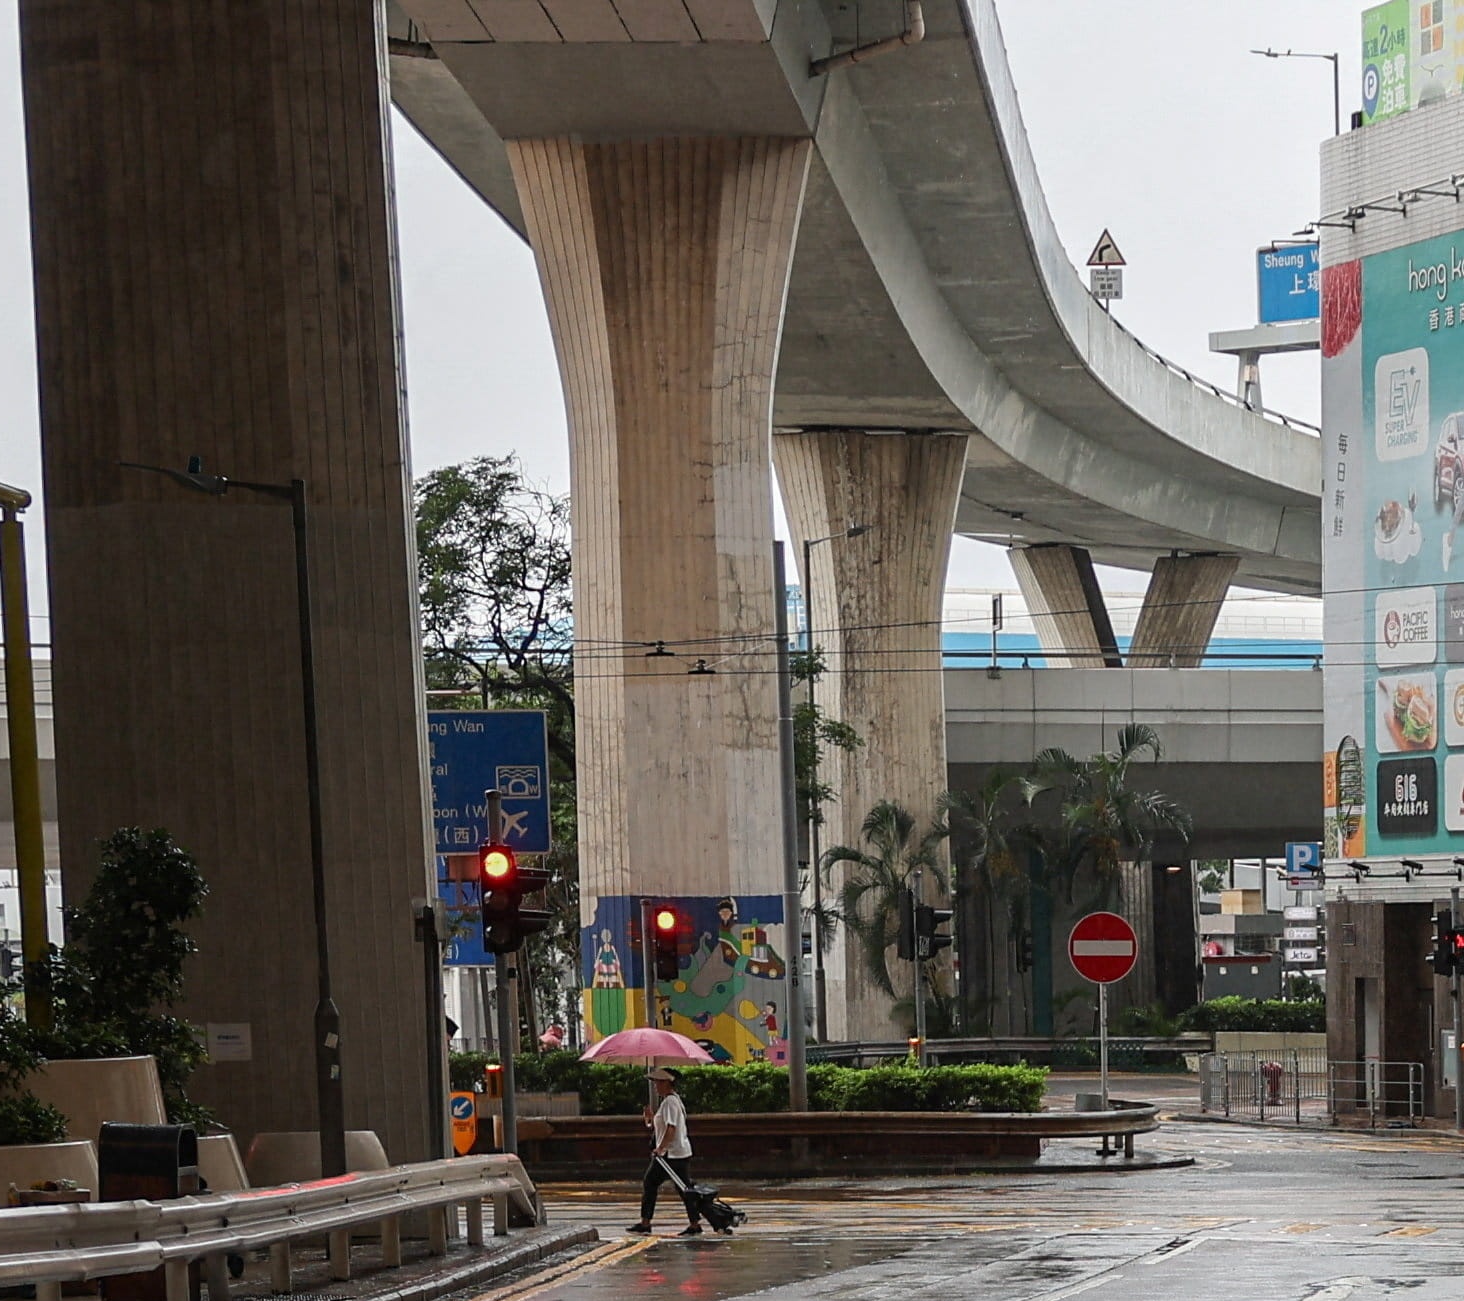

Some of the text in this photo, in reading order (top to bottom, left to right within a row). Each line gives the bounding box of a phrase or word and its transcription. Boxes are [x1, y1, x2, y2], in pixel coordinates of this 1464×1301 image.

[1264, 252, 1304, 269] Sheung
[1408, 259, 1447, 300] hong
[1385, 421, 1405, 434] SUPER
[1386, 431, 1418, 448] CHARGING
[1402, 611, 1429, 626] PACIFIC
[1403, 625, 1429, 641] COFFEE
[428, 720, 485, 736] ng Wan
[430, 764, 448, 777] ral
[1395, 773, 1418, 801] 616
[1292, 845, 1312, 872] P
